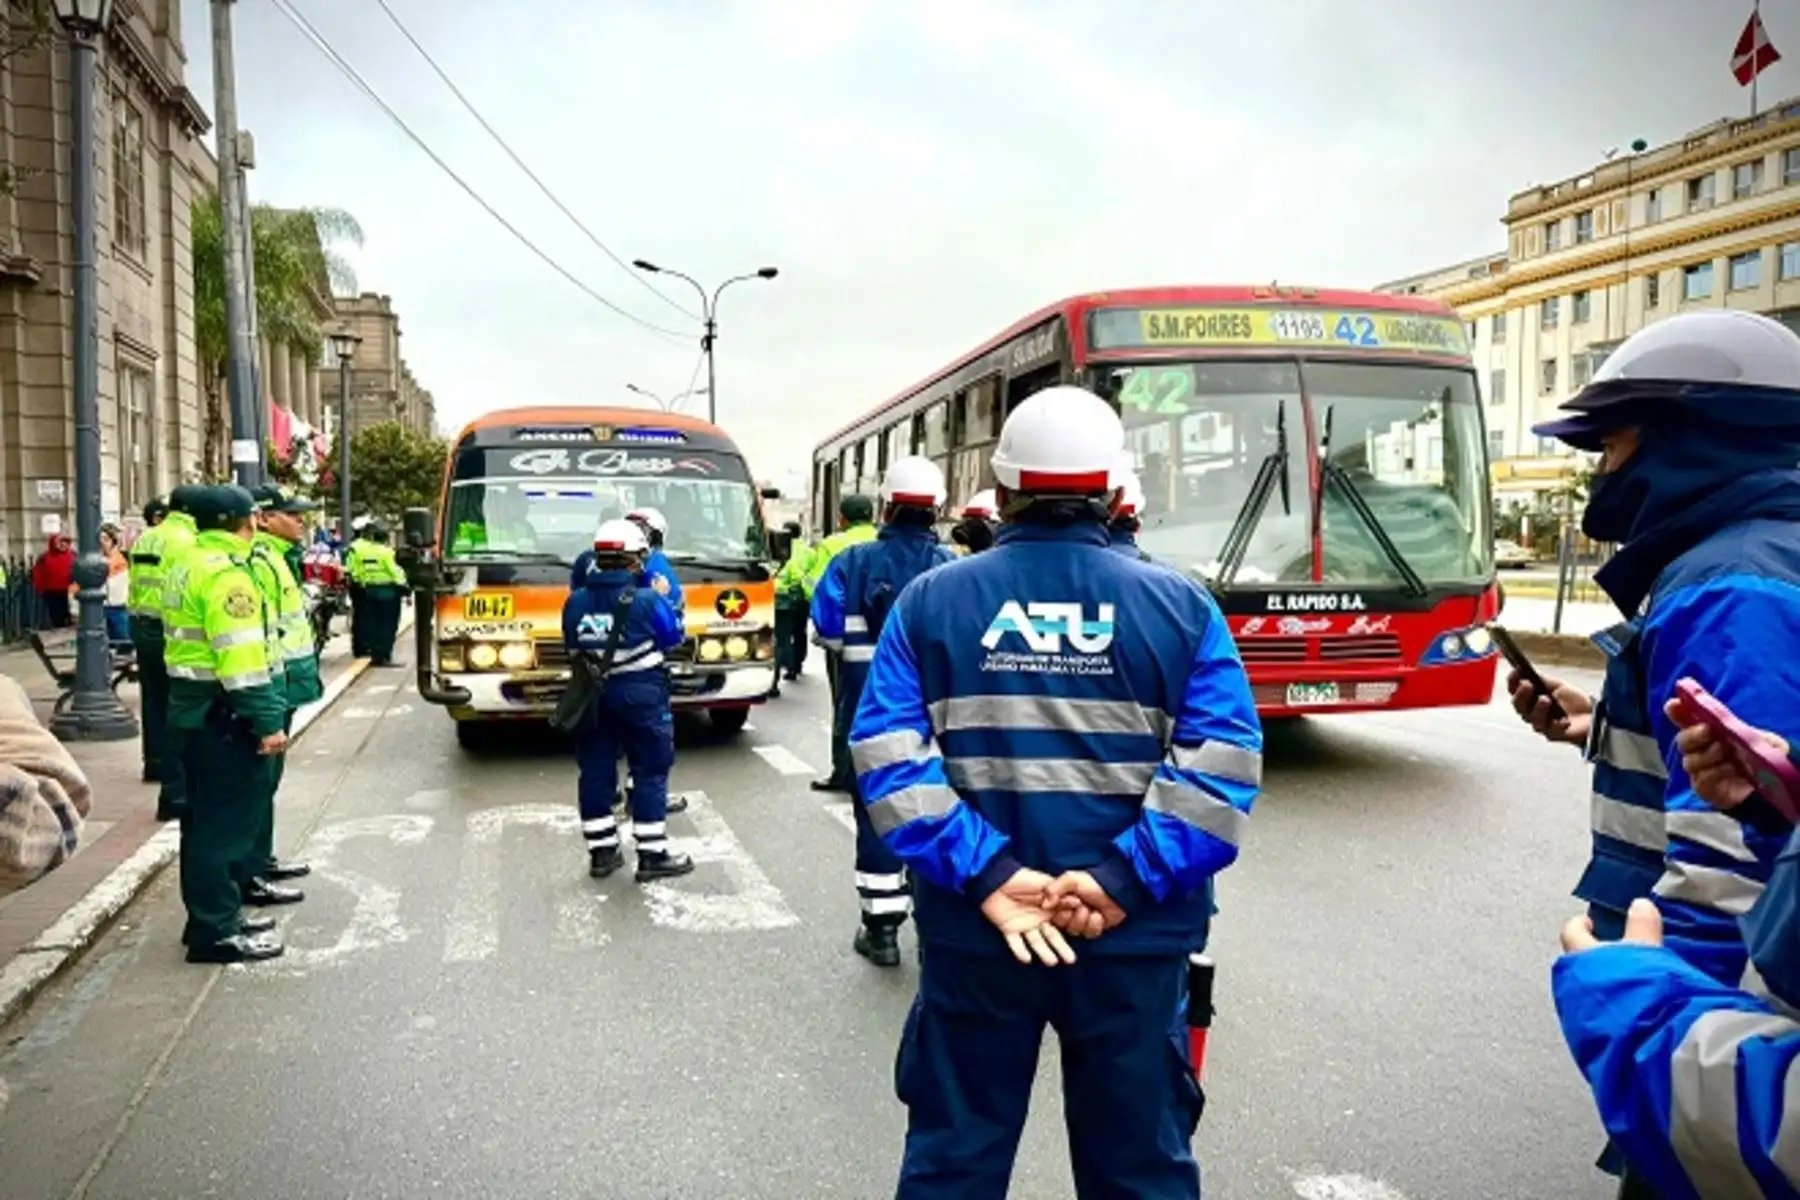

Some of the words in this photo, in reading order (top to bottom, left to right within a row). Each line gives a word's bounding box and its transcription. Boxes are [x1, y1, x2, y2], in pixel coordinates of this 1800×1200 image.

[1335, 315, 1379, 346] 42
[1118, 369, 1189, 412] 42
[1267, 594, 1285, 610] EL
[980, 600, 1115, 653] ATU
